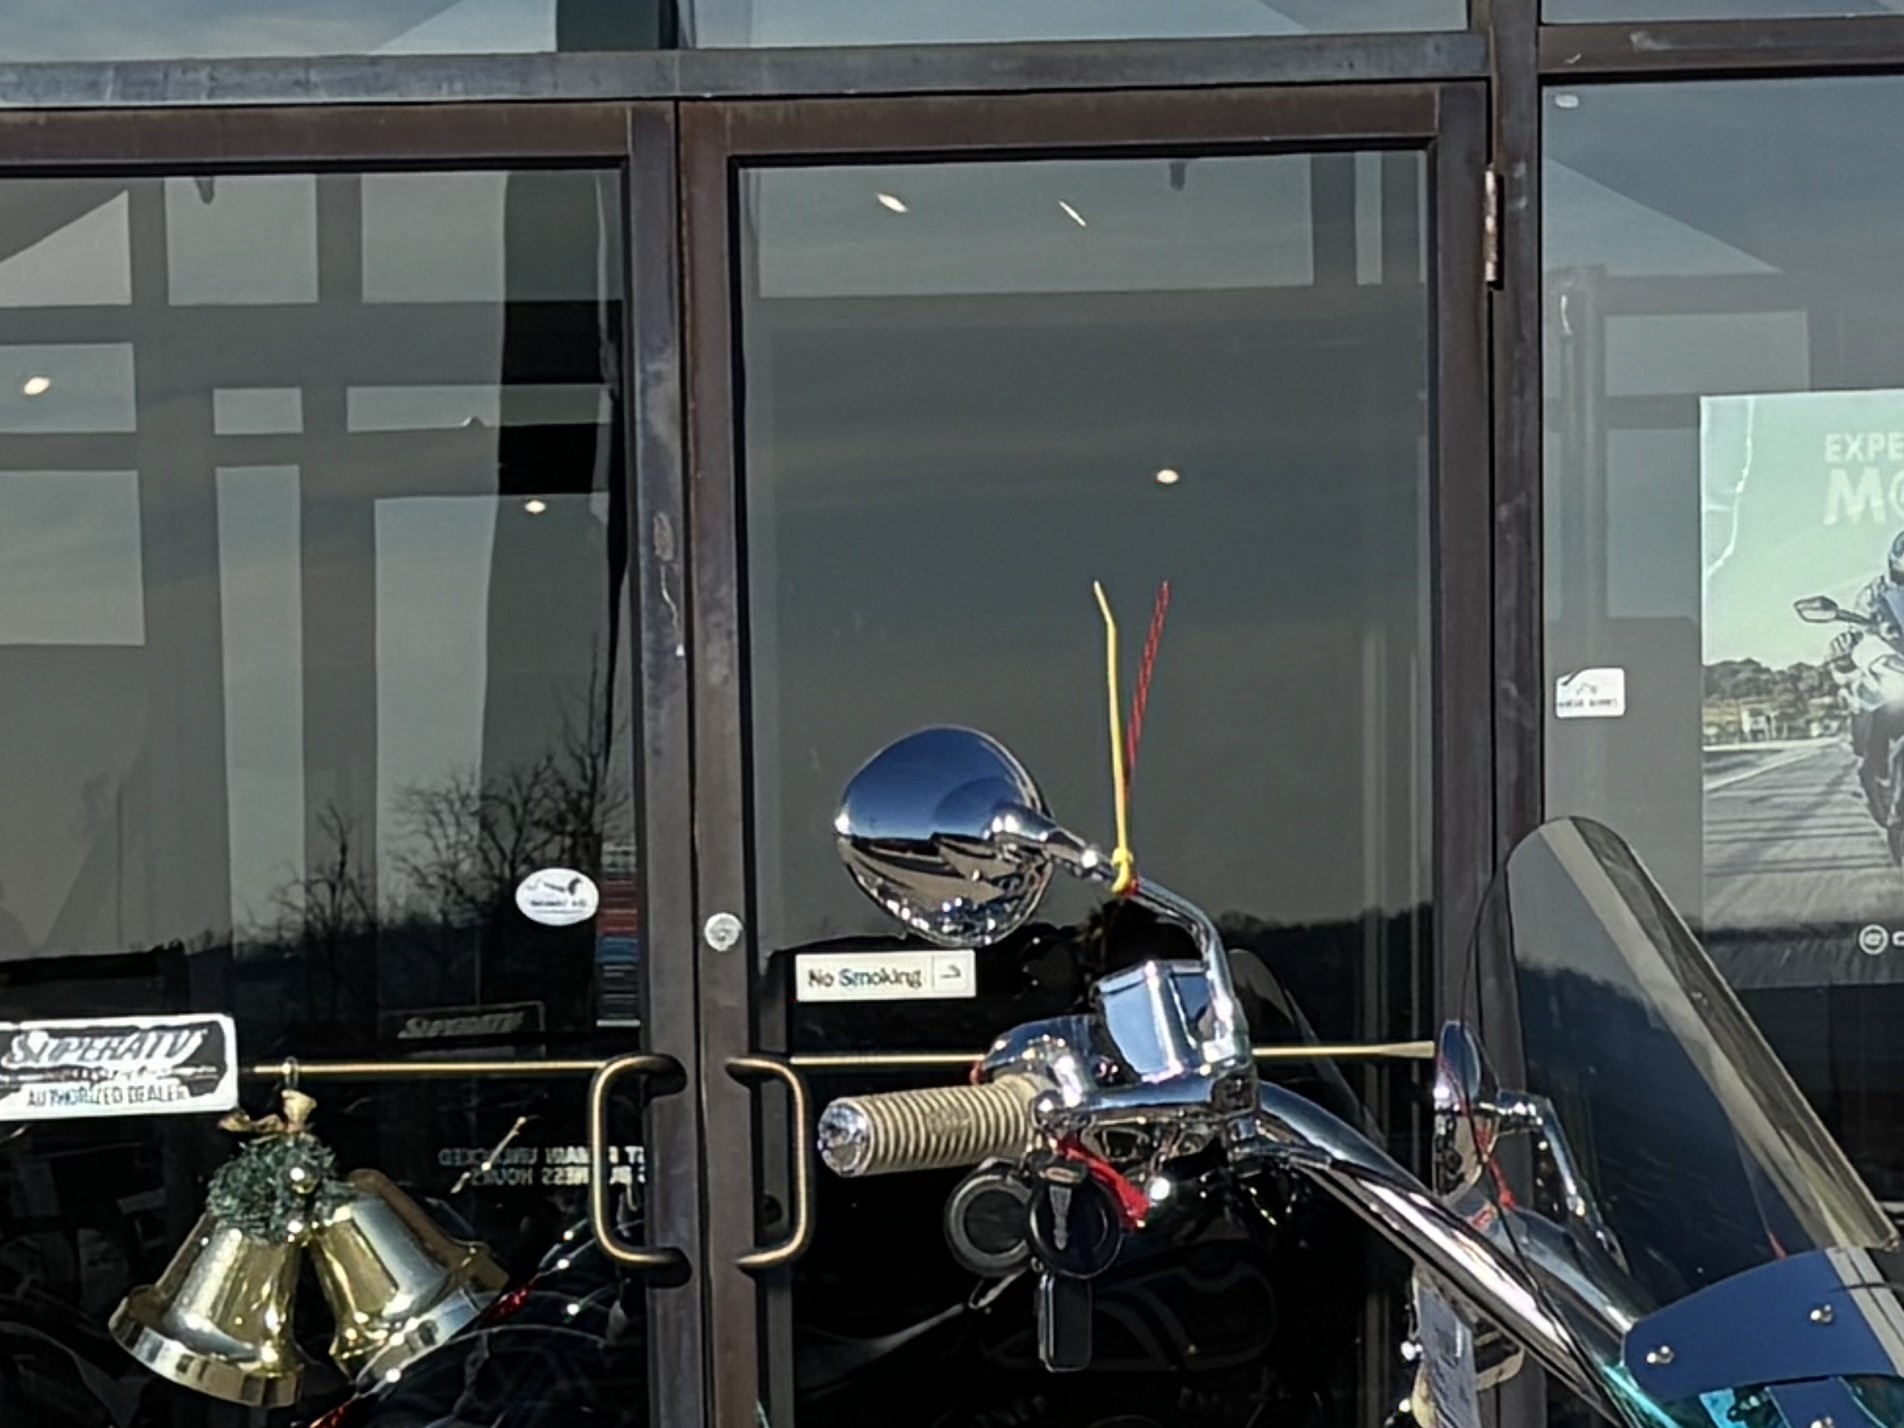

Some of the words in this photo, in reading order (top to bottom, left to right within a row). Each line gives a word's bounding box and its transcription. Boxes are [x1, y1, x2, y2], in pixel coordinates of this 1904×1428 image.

[808, 969, 834, 987] No
[839, 967, 923, 989] Smoking
[27, 1084, 124, 1108] AUTHORIZED
[128, 1083, 187, 1103] DEALER
